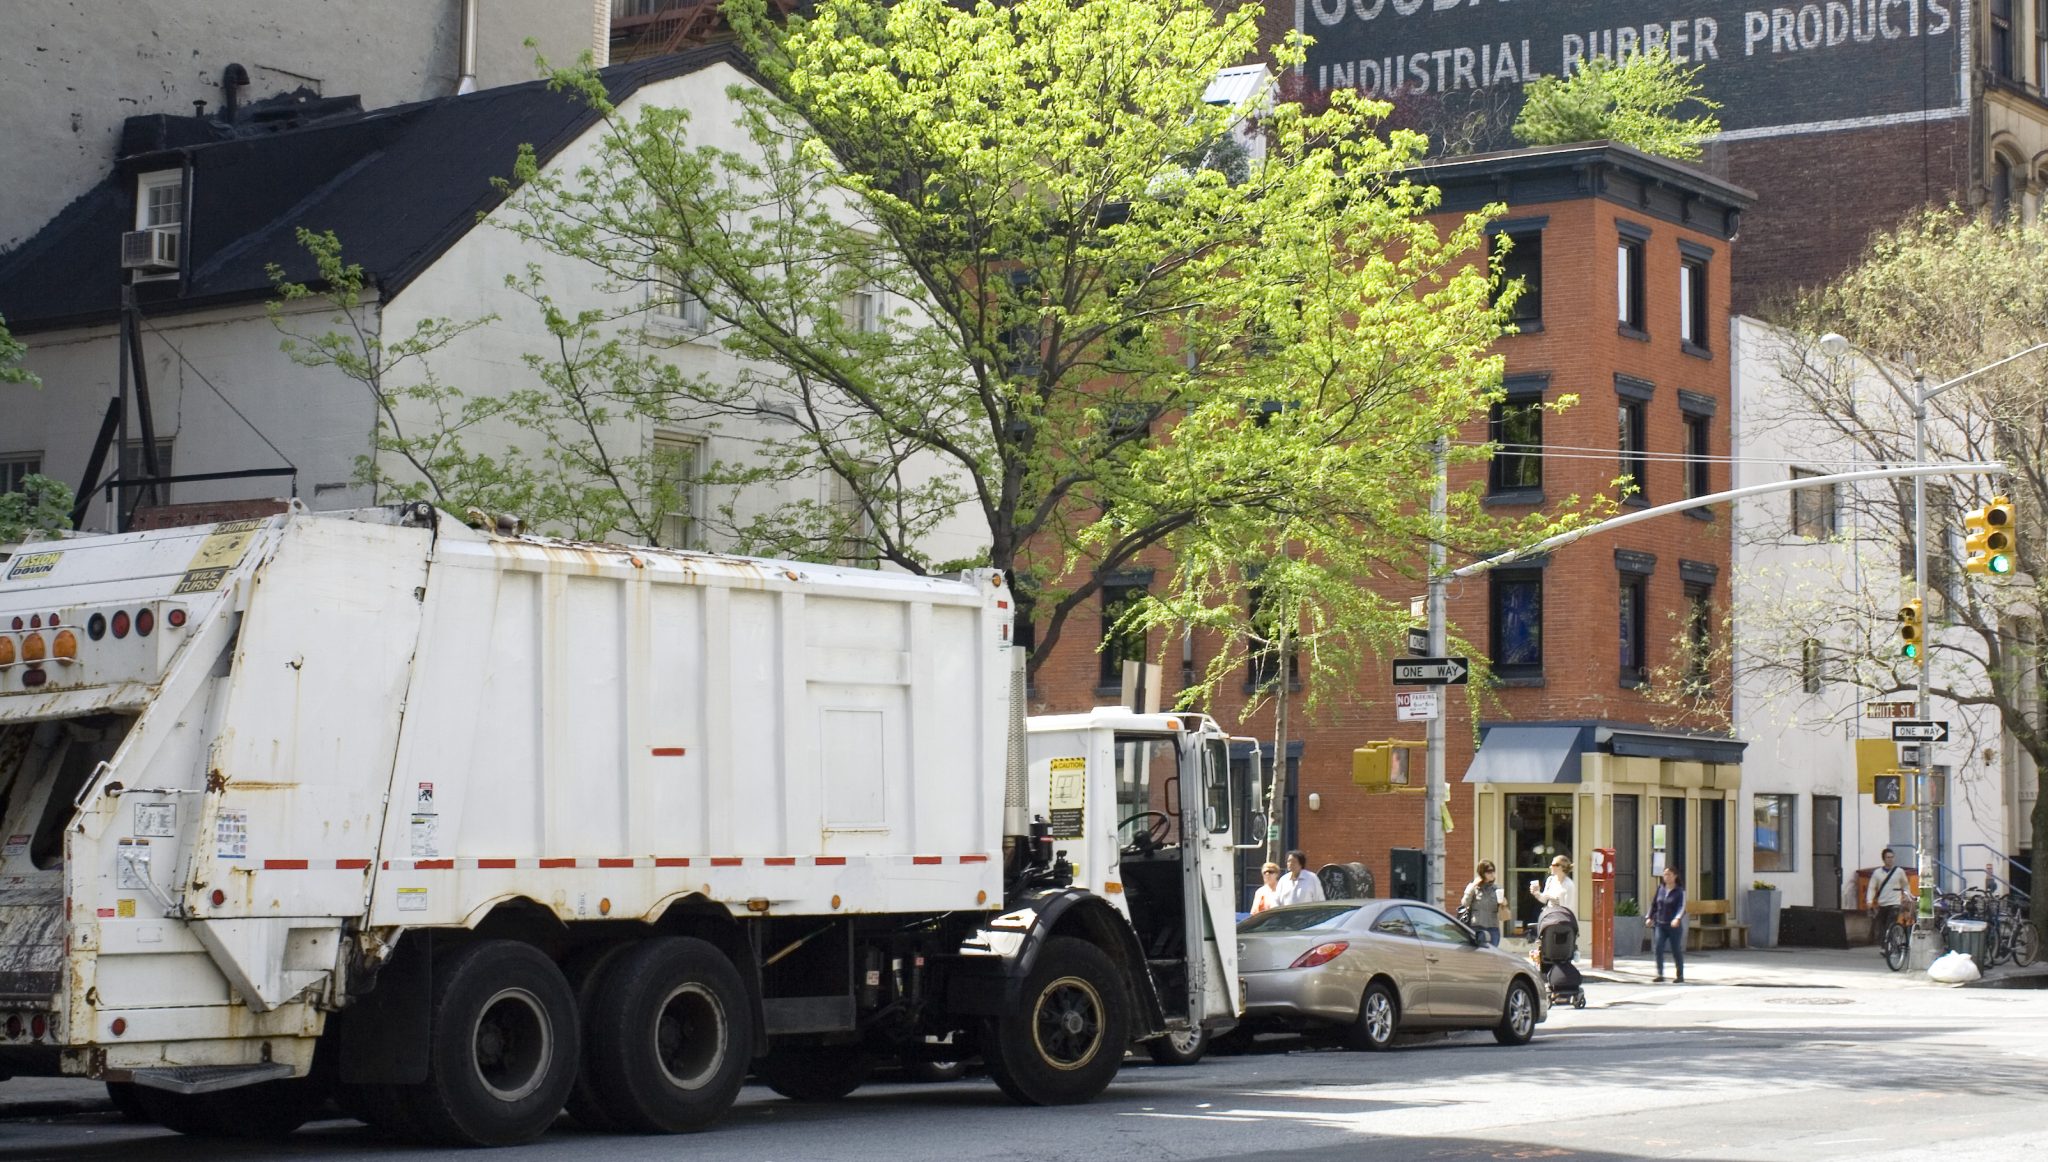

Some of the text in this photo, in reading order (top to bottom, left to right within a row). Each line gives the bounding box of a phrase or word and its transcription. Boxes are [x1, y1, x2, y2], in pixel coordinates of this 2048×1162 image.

[1319, 0, 1951, 97] INDUSTRIAL RUBBER PRODUCTS
[12, 565, 54, 576] DOWN
[190, 570, 220, 580] WIDE
[179, 579, 219, 592] TURNS
[1413, 636, 1424, 649] ONE
[1402, 666, 1459, 677] ONE WAY
[1397, 695, 1410, 706] NO
[1870, 705, 1911, 717] WHITE ST
[1923, 727, 1940, 735] WAY
[1906, 752, 1918, 760] ONE
